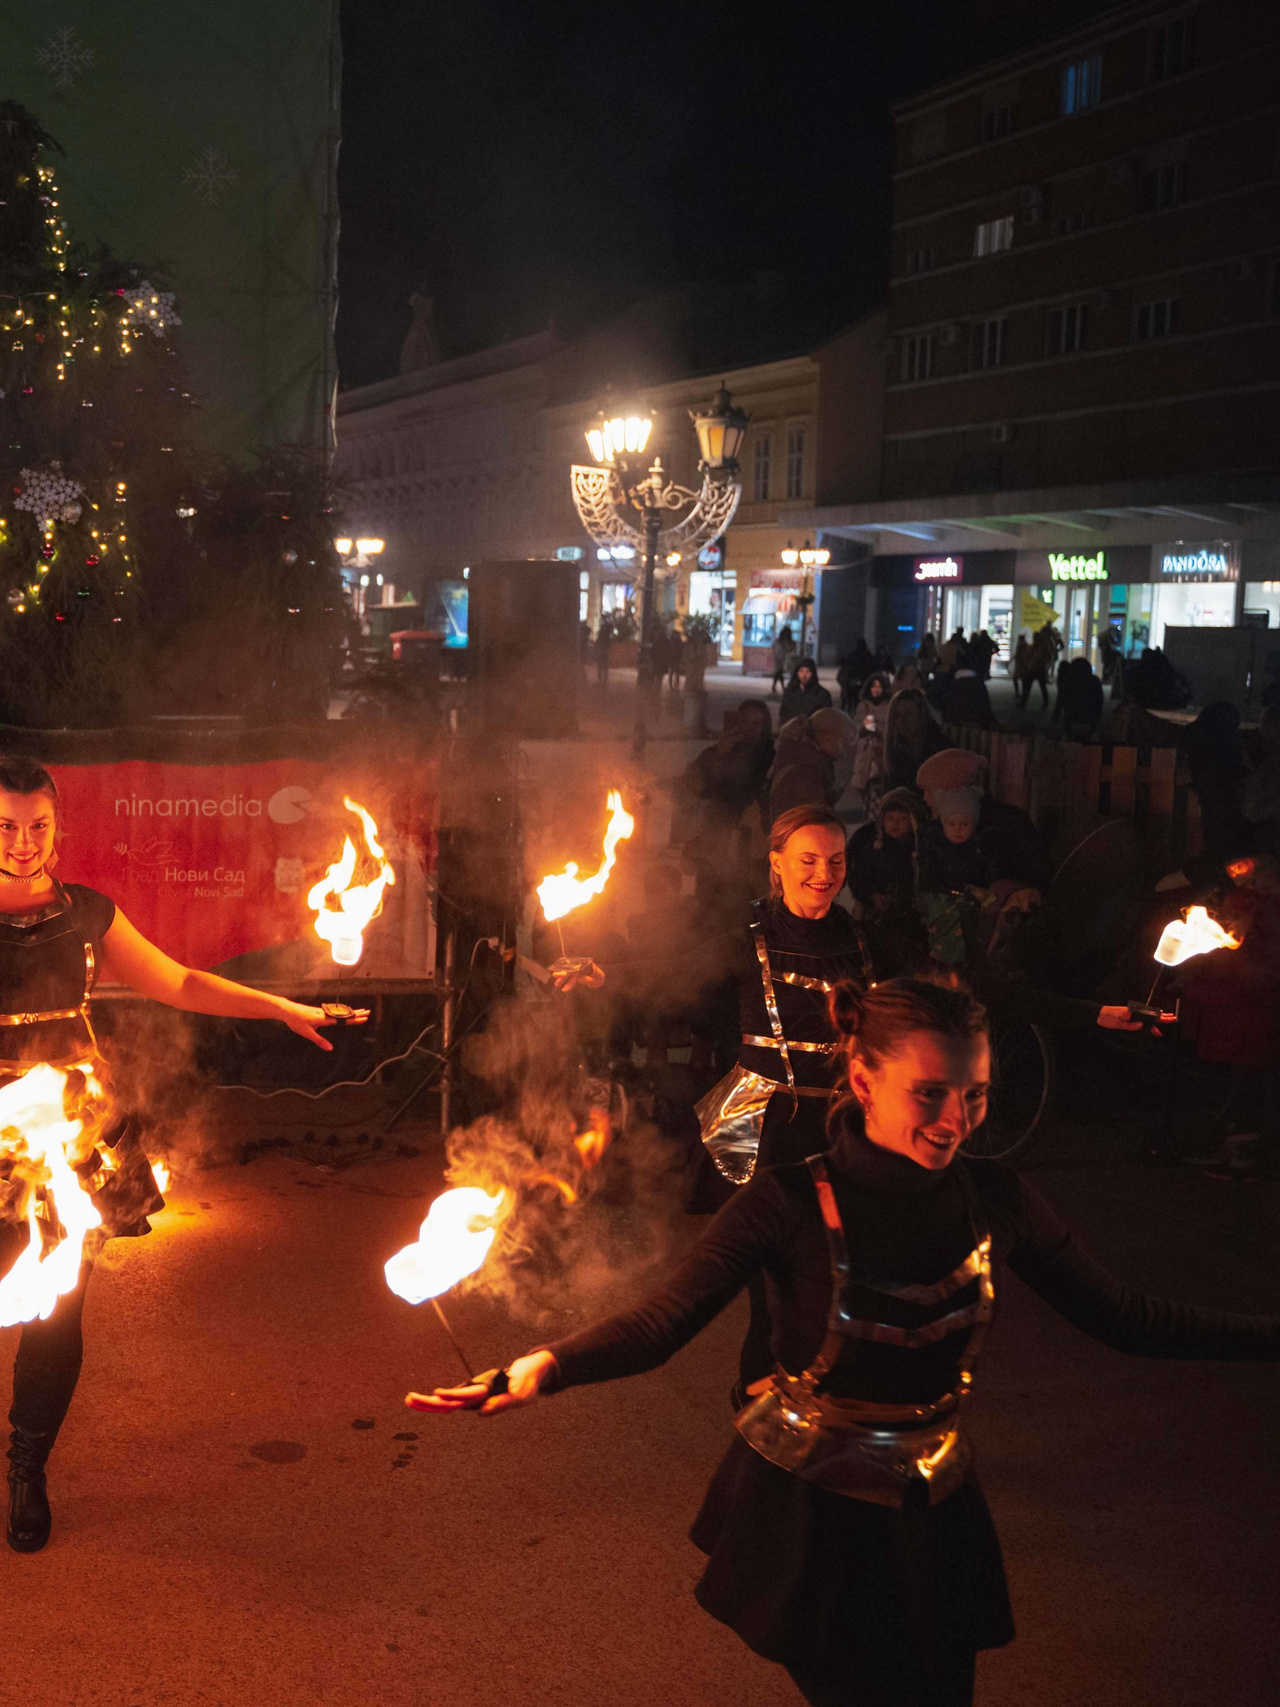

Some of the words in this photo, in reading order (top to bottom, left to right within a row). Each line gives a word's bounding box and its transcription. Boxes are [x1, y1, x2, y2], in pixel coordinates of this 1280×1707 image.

[1162, 549, 1228, 573] PANDORA
[115, 793, 262, 816] ninamedia
[165, 867, 209, 882] Нови
[213, 867, 245, 883] Сад
[194, 887, 219, 897] Novi
[223, 887, 244, 897] Sad
